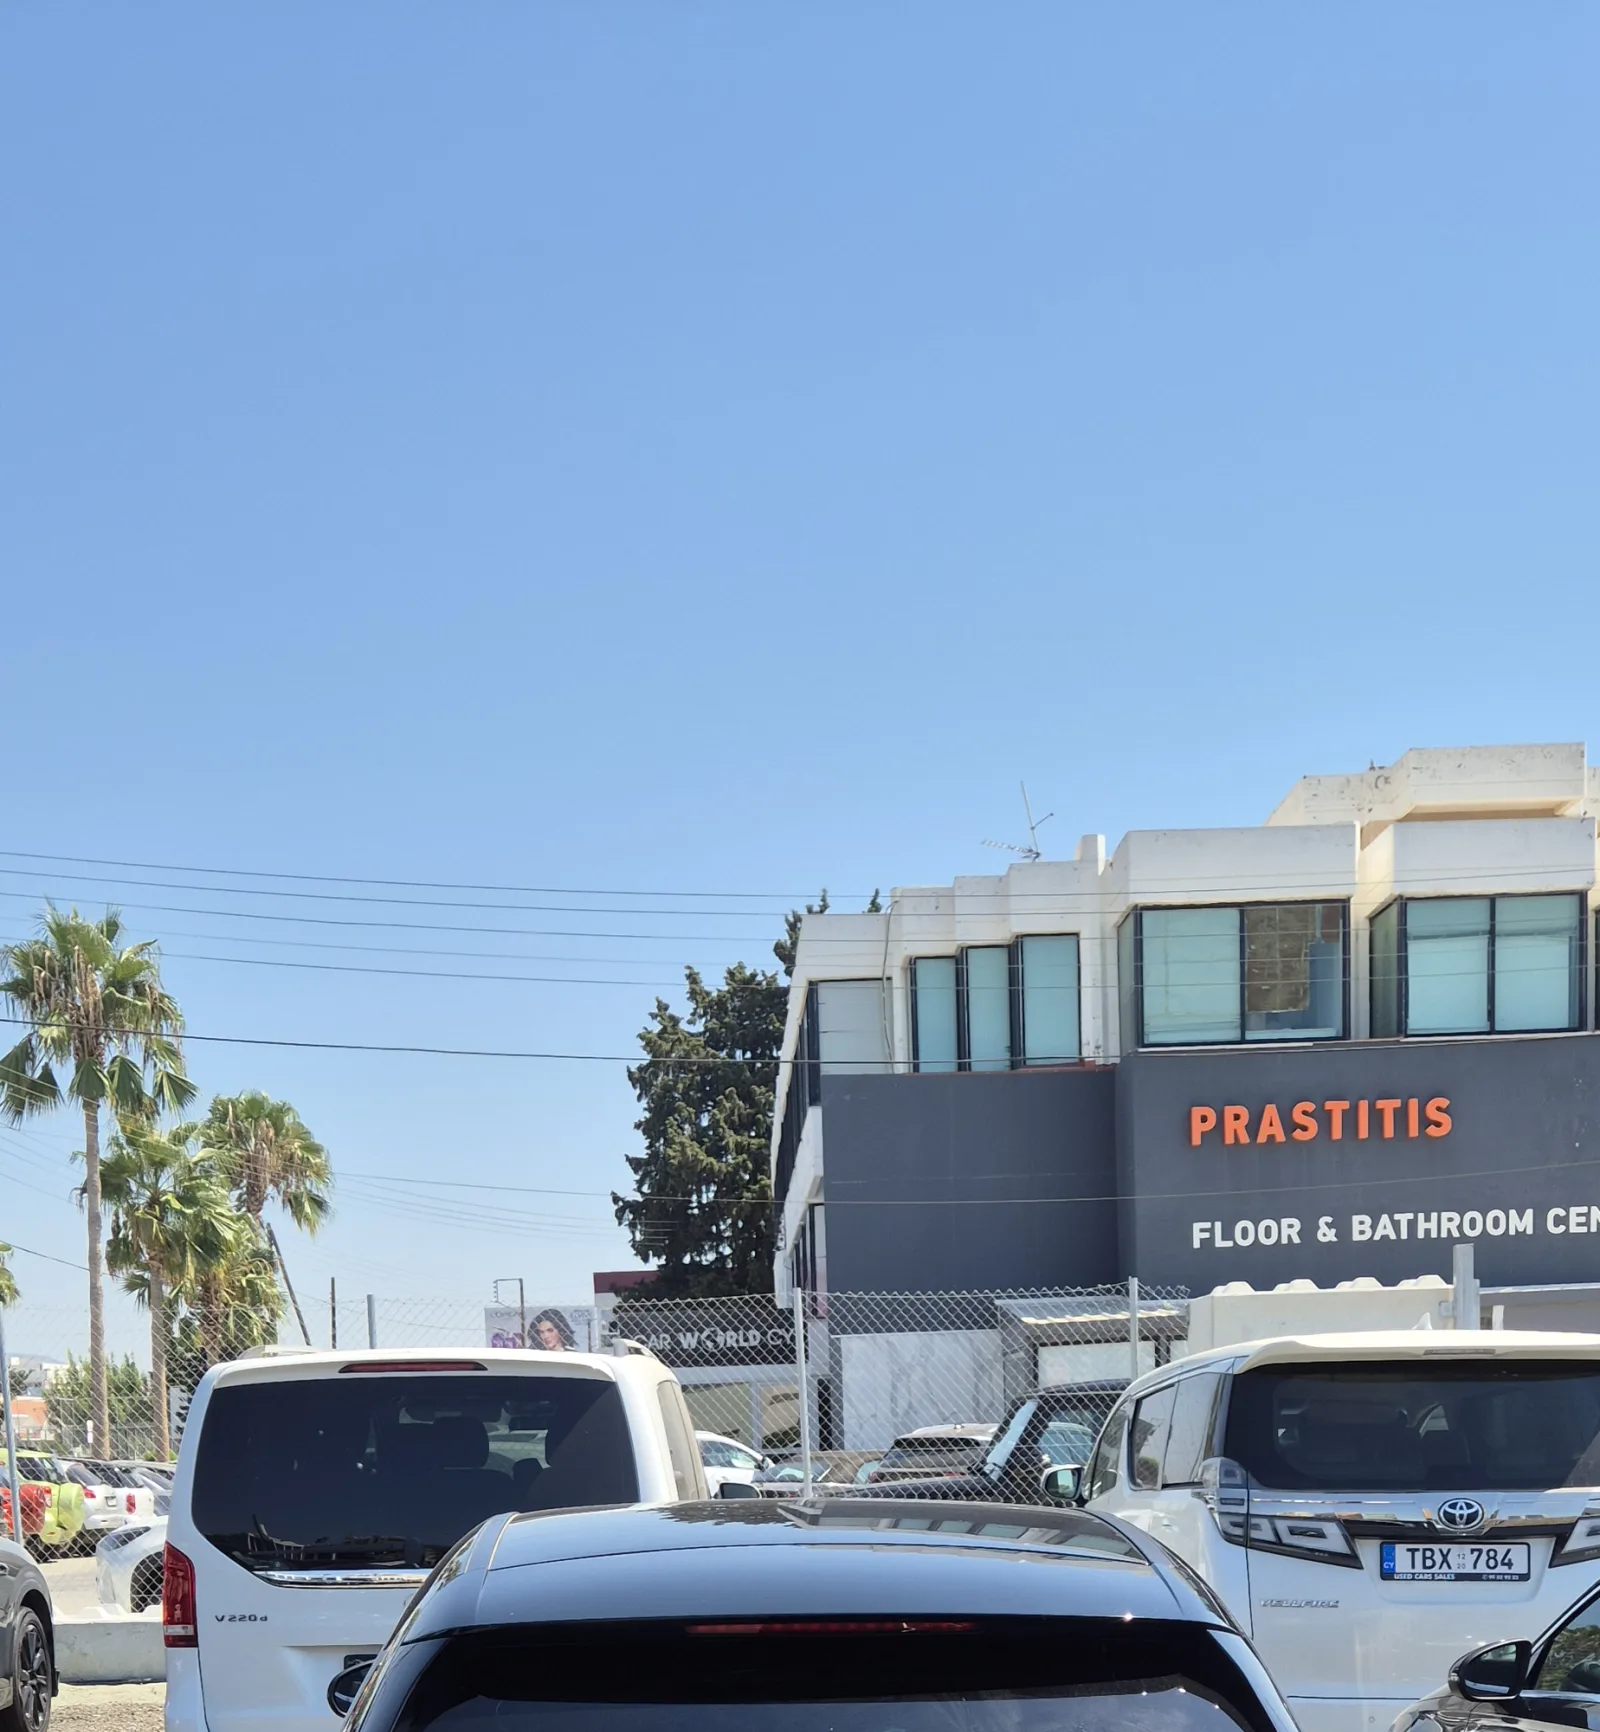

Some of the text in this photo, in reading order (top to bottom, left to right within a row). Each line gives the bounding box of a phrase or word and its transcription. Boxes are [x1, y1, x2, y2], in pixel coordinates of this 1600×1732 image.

[1190, 1097, 1453, 1146] PRASTITIS
[1192, 1217, 1301, 1249] FLOOR
[1316, 1215, 1338, 1242] &
[1352, 1208, 1534, 1241] BATHROOM
[633, 1333, 672, 1350] CAR
[677, 1327, 762, 1352] WORLD
[1406, 1547, 1514, 1570] TBX 784
[1260, 1599, 1339, 1608] VELLFIRE
[214, 1614, 225, 1622] V
